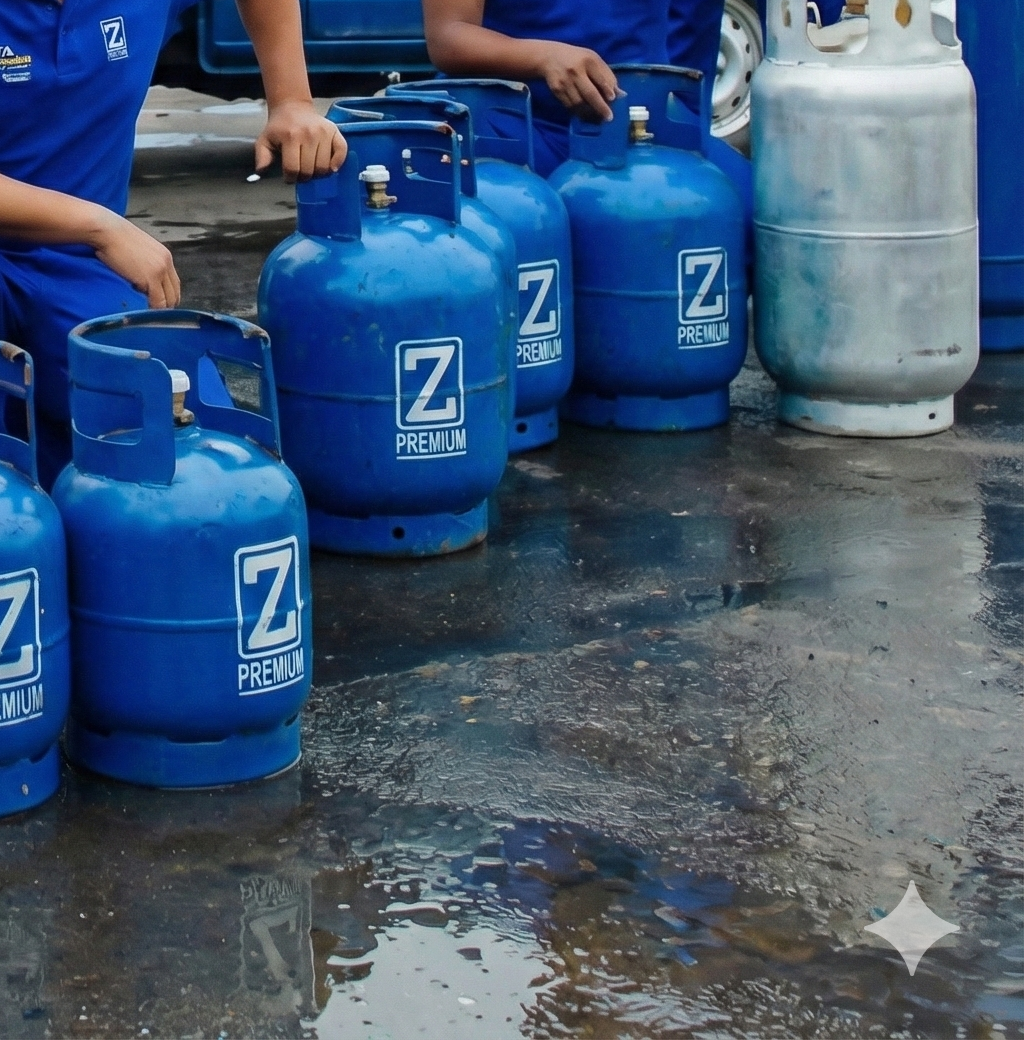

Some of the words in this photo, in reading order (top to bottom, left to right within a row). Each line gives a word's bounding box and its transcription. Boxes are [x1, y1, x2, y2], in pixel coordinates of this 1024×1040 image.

[104, 22, 124, 48] Z
[518, 268, 556, 335] Z
[685, 254, 724, 317] Z
[677, 322, 729, 345] PREMIUM
[404, 345, 456, 422] Z
[396, 428, 467, 453] PREMIUM
[243, 548, 296, 650] Z
[238, 647, 304, 690] PREMIUM
